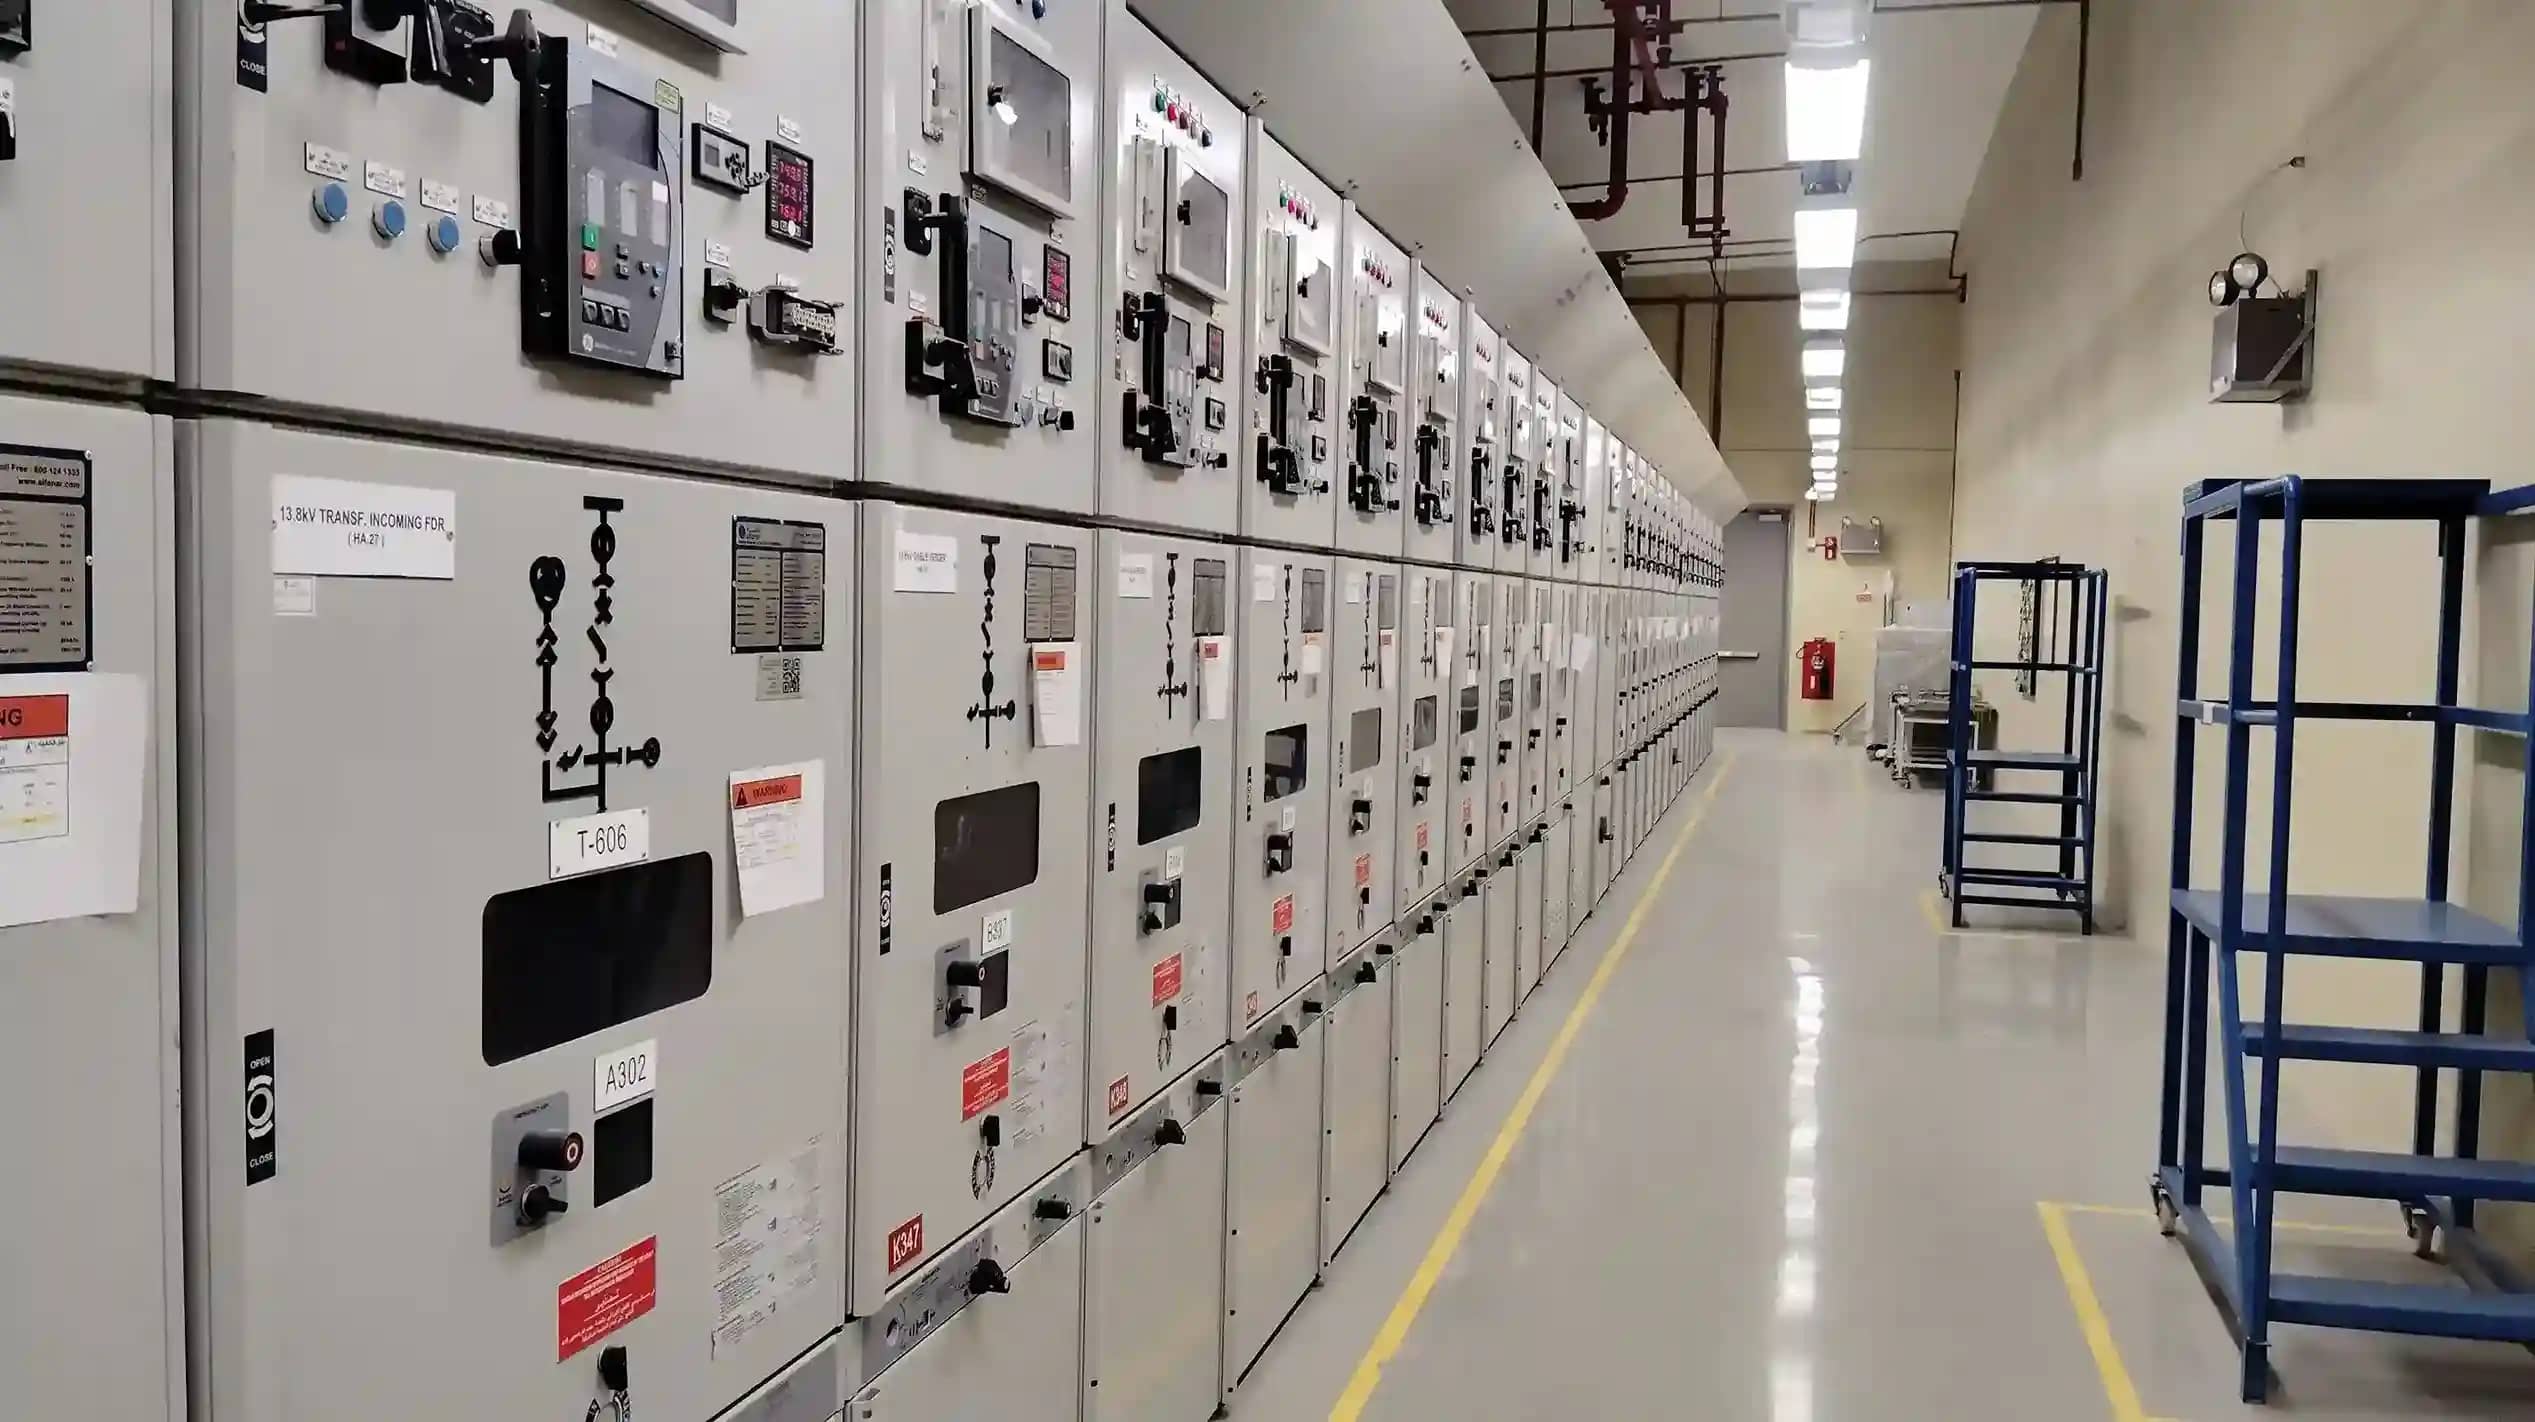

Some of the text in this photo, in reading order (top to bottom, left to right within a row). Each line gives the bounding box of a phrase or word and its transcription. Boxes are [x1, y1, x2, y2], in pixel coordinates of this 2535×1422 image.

[240, 59, 265, 75] CLOSE
[280, 505, 445, 532] 13.8kV TRANSF. INCOMING FDR
[577, 824, 627, 859] T-606
[250, 1056, 271, 1069] OPEN
[605, 1054, 647, 1094] A302
[249, 1152, 274, 1168] CLOSE
[893, 1222, 920, 1265] K347
